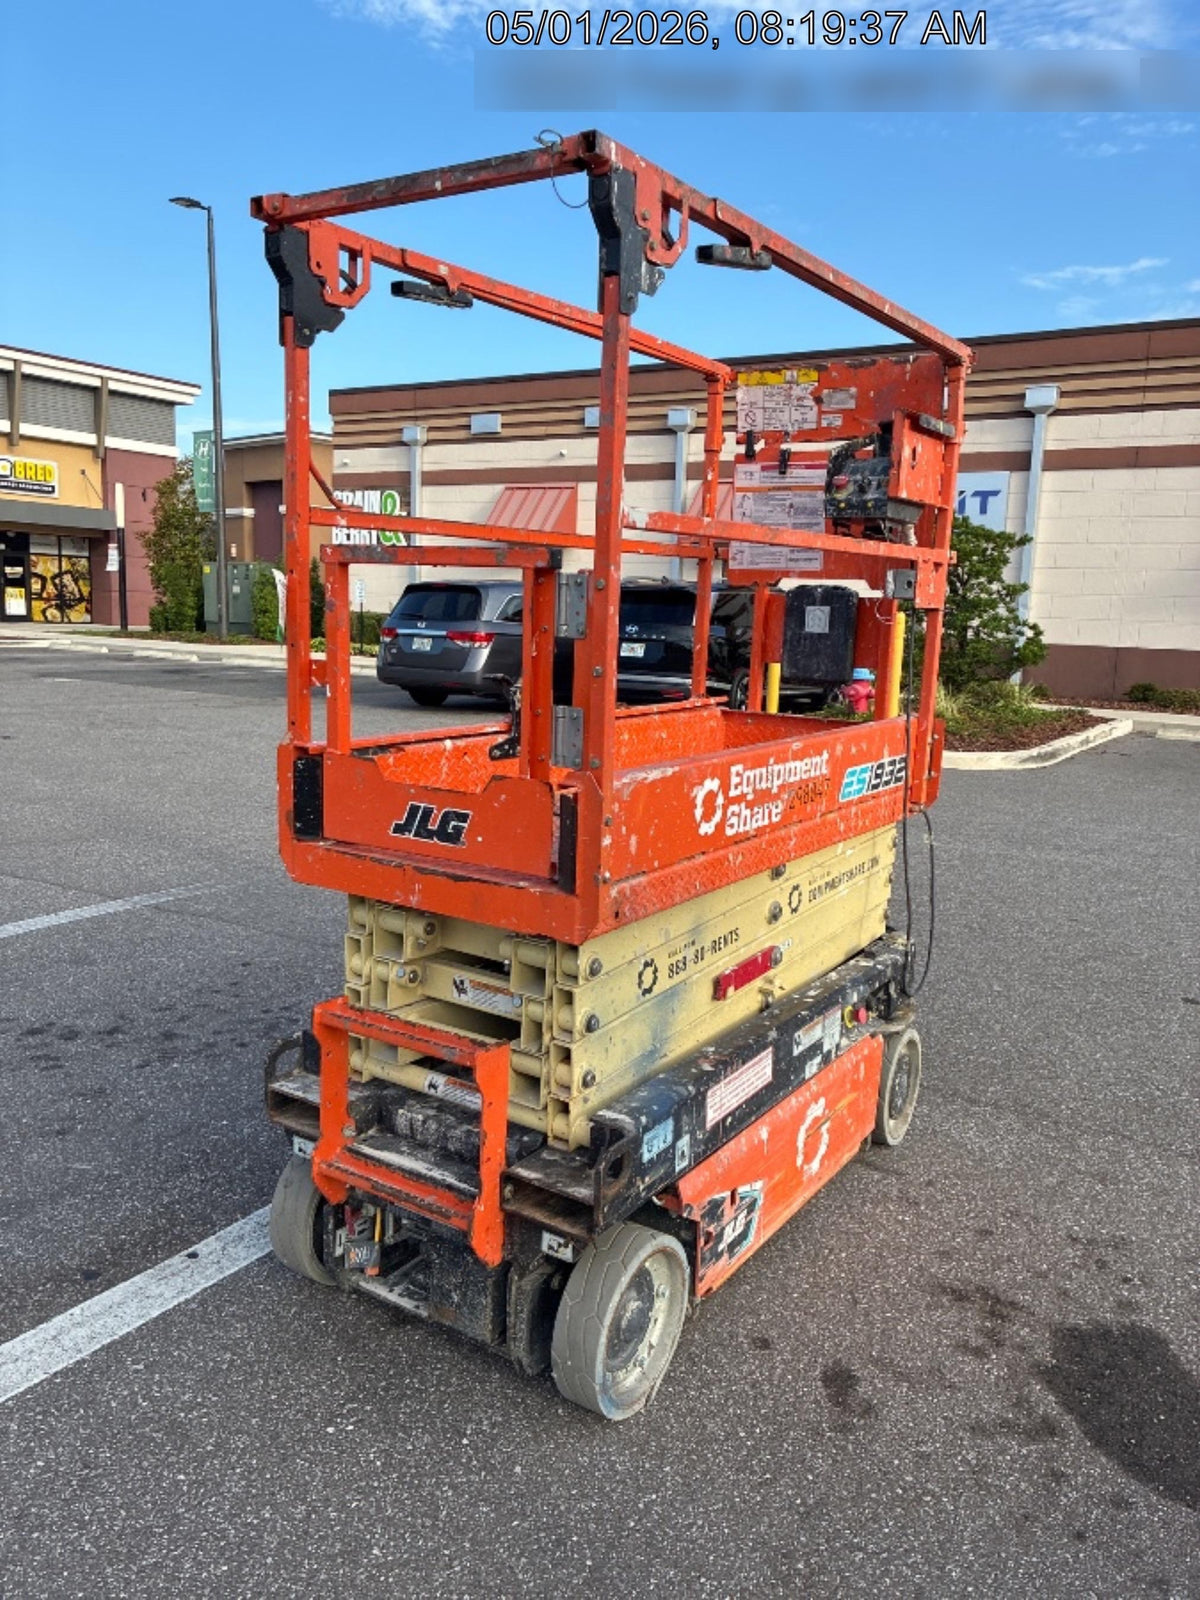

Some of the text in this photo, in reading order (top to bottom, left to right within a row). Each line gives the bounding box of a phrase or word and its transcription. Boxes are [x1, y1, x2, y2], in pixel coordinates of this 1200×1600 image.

[13, 460, 55, 483] BRED
[728, 750, 830, 800] Equipment
[390, 801, 473, 848] JLG
[724, 799, 783, 836] Share
